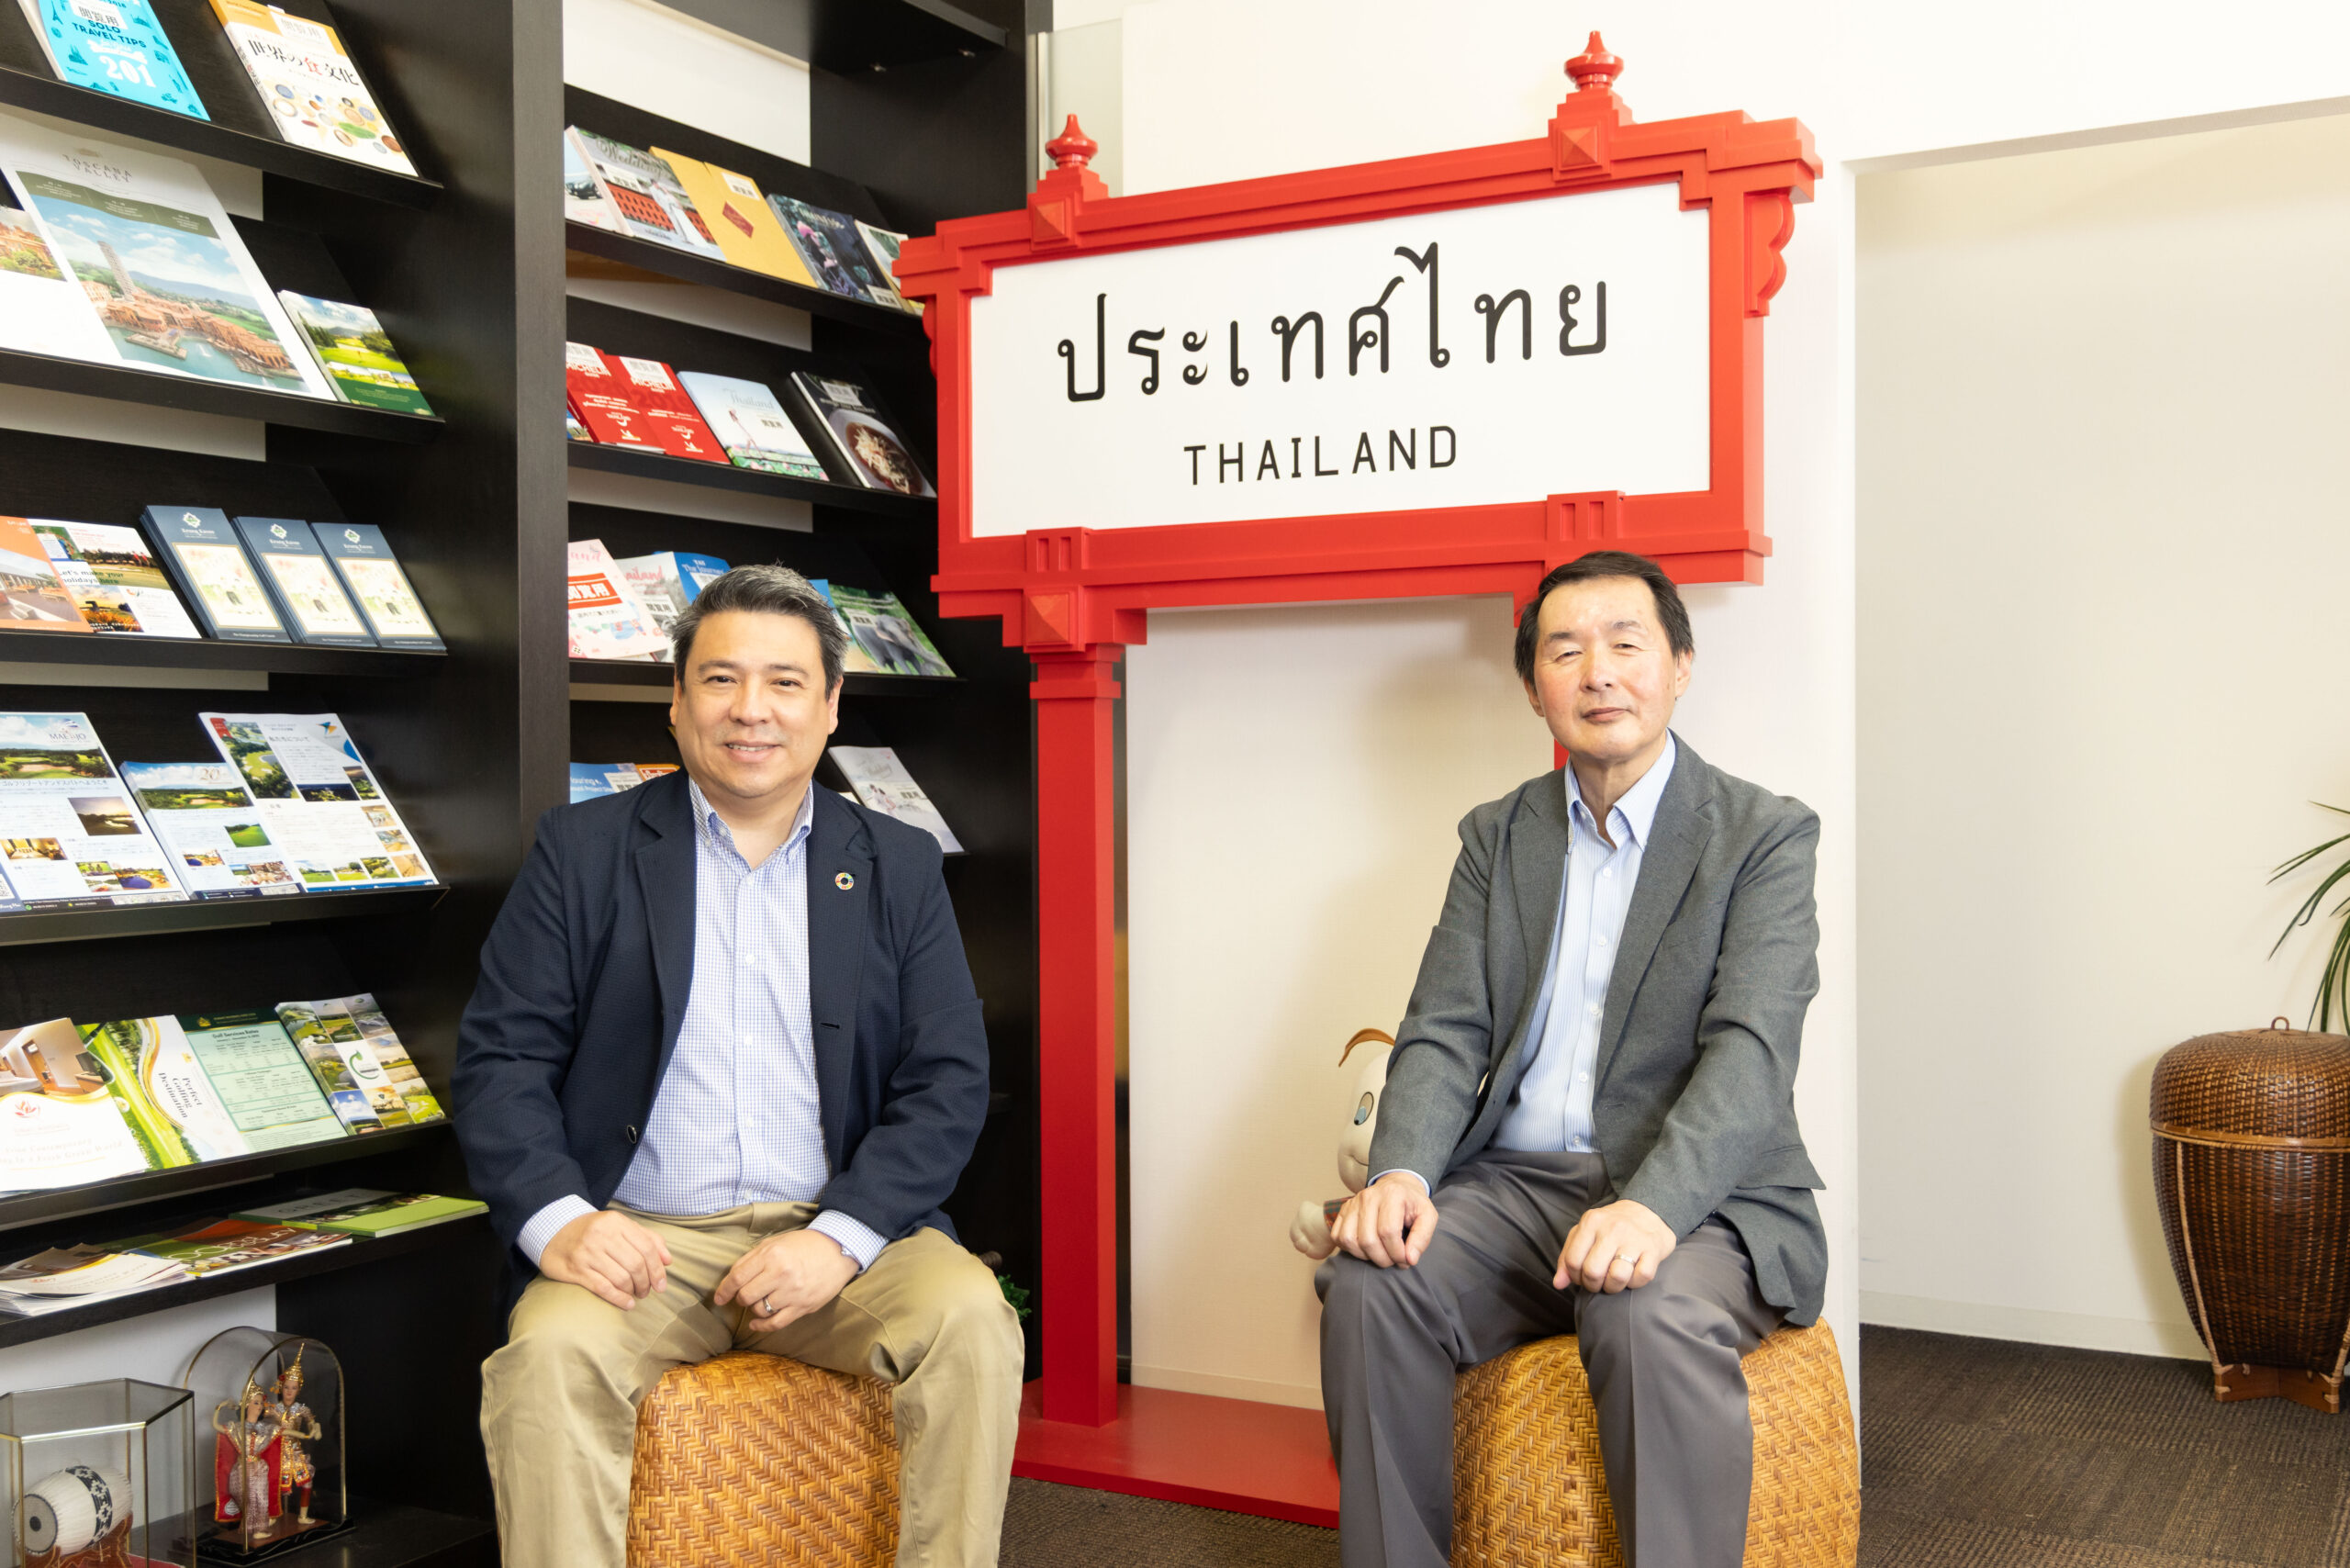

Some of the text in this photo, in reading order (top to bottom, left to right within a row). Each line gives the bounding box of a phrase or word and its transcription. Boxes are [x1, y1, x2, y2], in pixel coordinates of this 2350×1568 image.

[72, 22, 147, 49] TRAVEL TIPS
[88, 19, 121, 34] SOLO
[62, 153, 133, 178] TOSCANA
[73, 162, 130, 184] VALLEY
[1057, 241, 1607, 403] ประเทศไทย
[630, 375, 677, 391] MICHELIN
[1183, 426, 1458, 487] THAILAND
[158, 1072, 188, 1118] Destination
[172, 1077, 193, 1109] Golfing
[182, 1077, 203, 1105] Perfect
